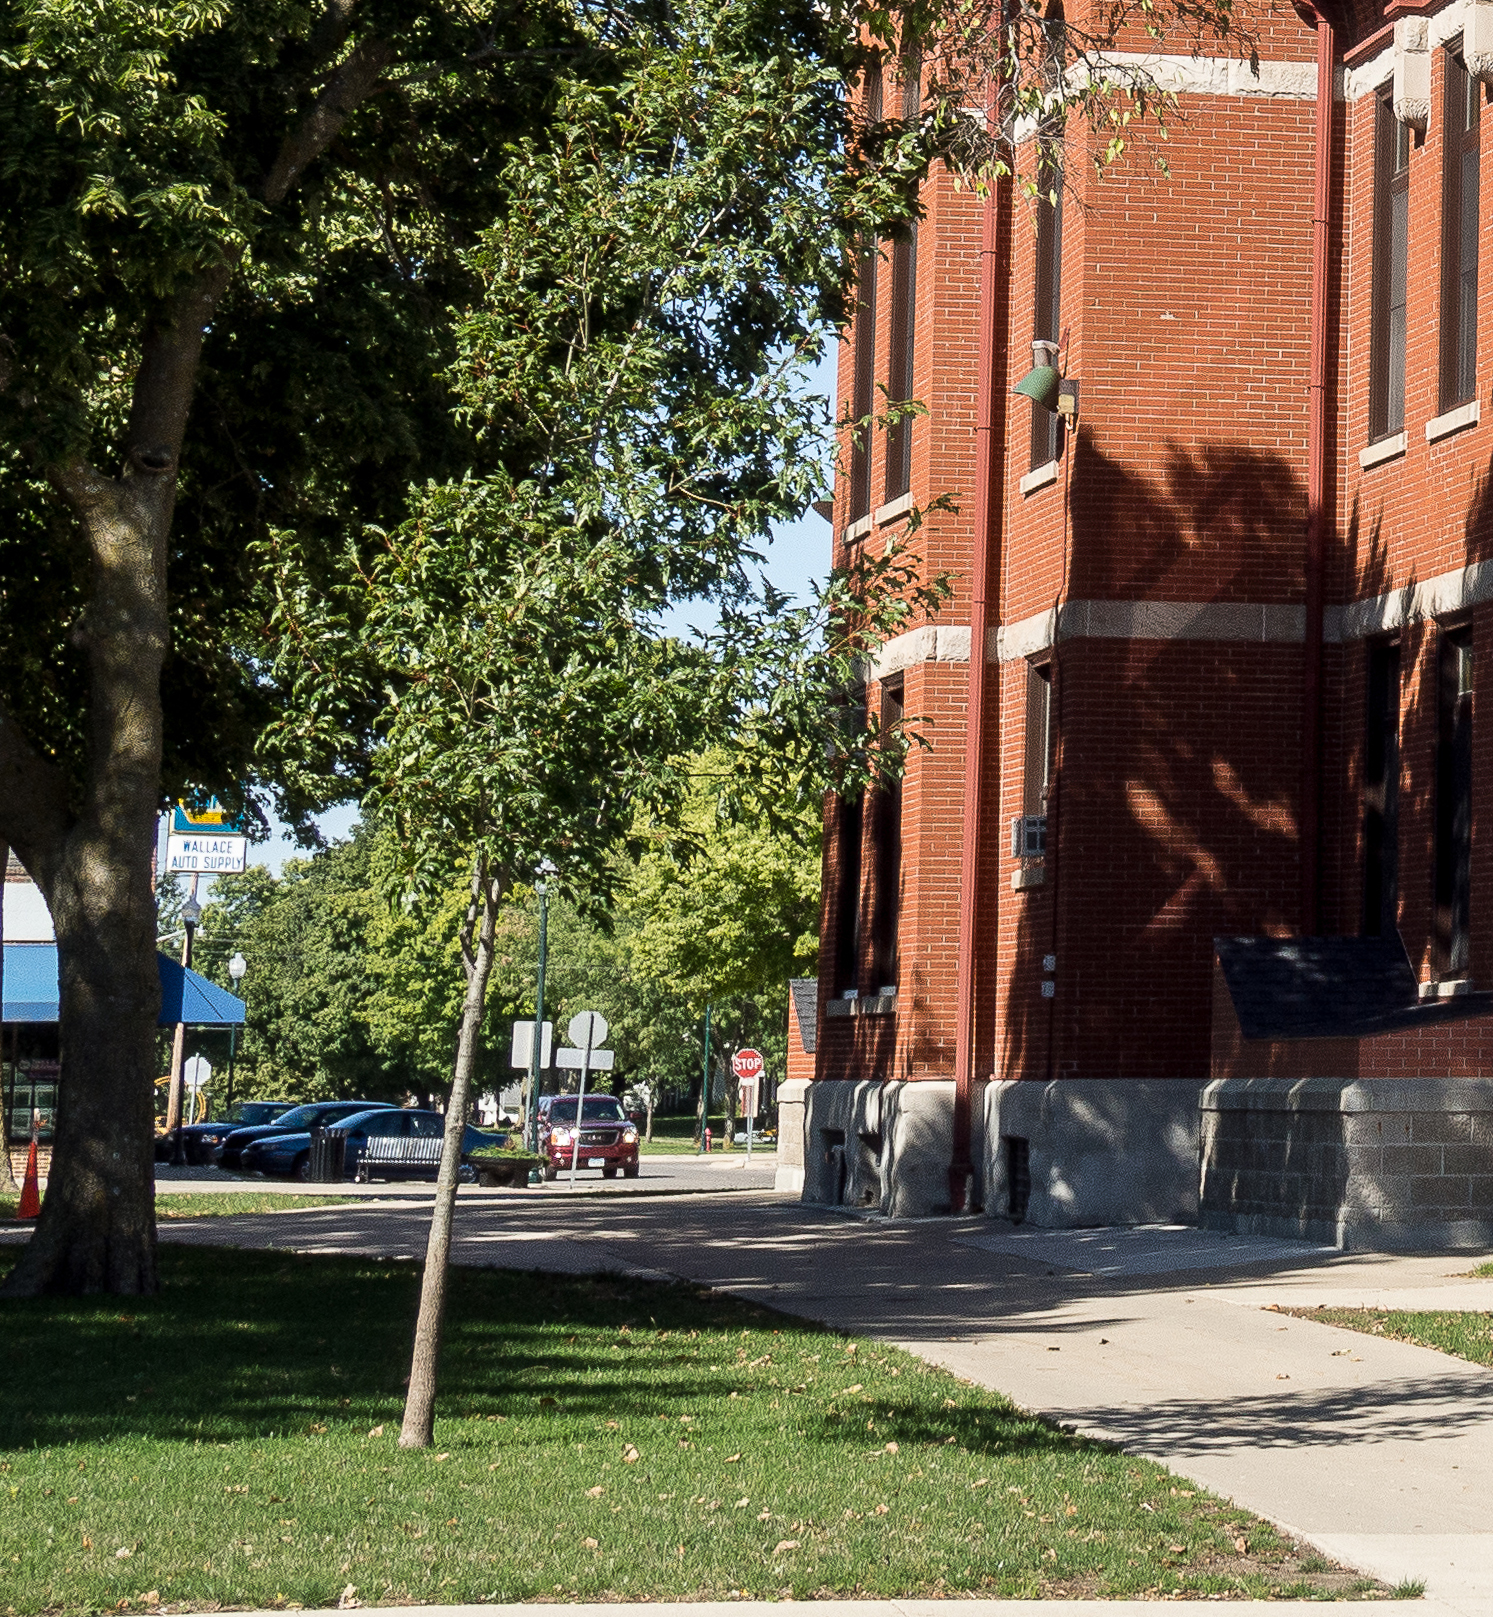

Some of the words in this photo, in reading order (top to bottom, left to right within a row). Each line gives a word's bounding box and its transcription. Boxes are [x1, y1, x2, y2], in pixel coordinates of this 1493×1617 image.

[183, 840, 232, 854] WALLACE
[171, 855, 198, 869] AUTO
[204, 856, 243, 870] SUPPLY
[735, 1058, 761, 1070] STOP
